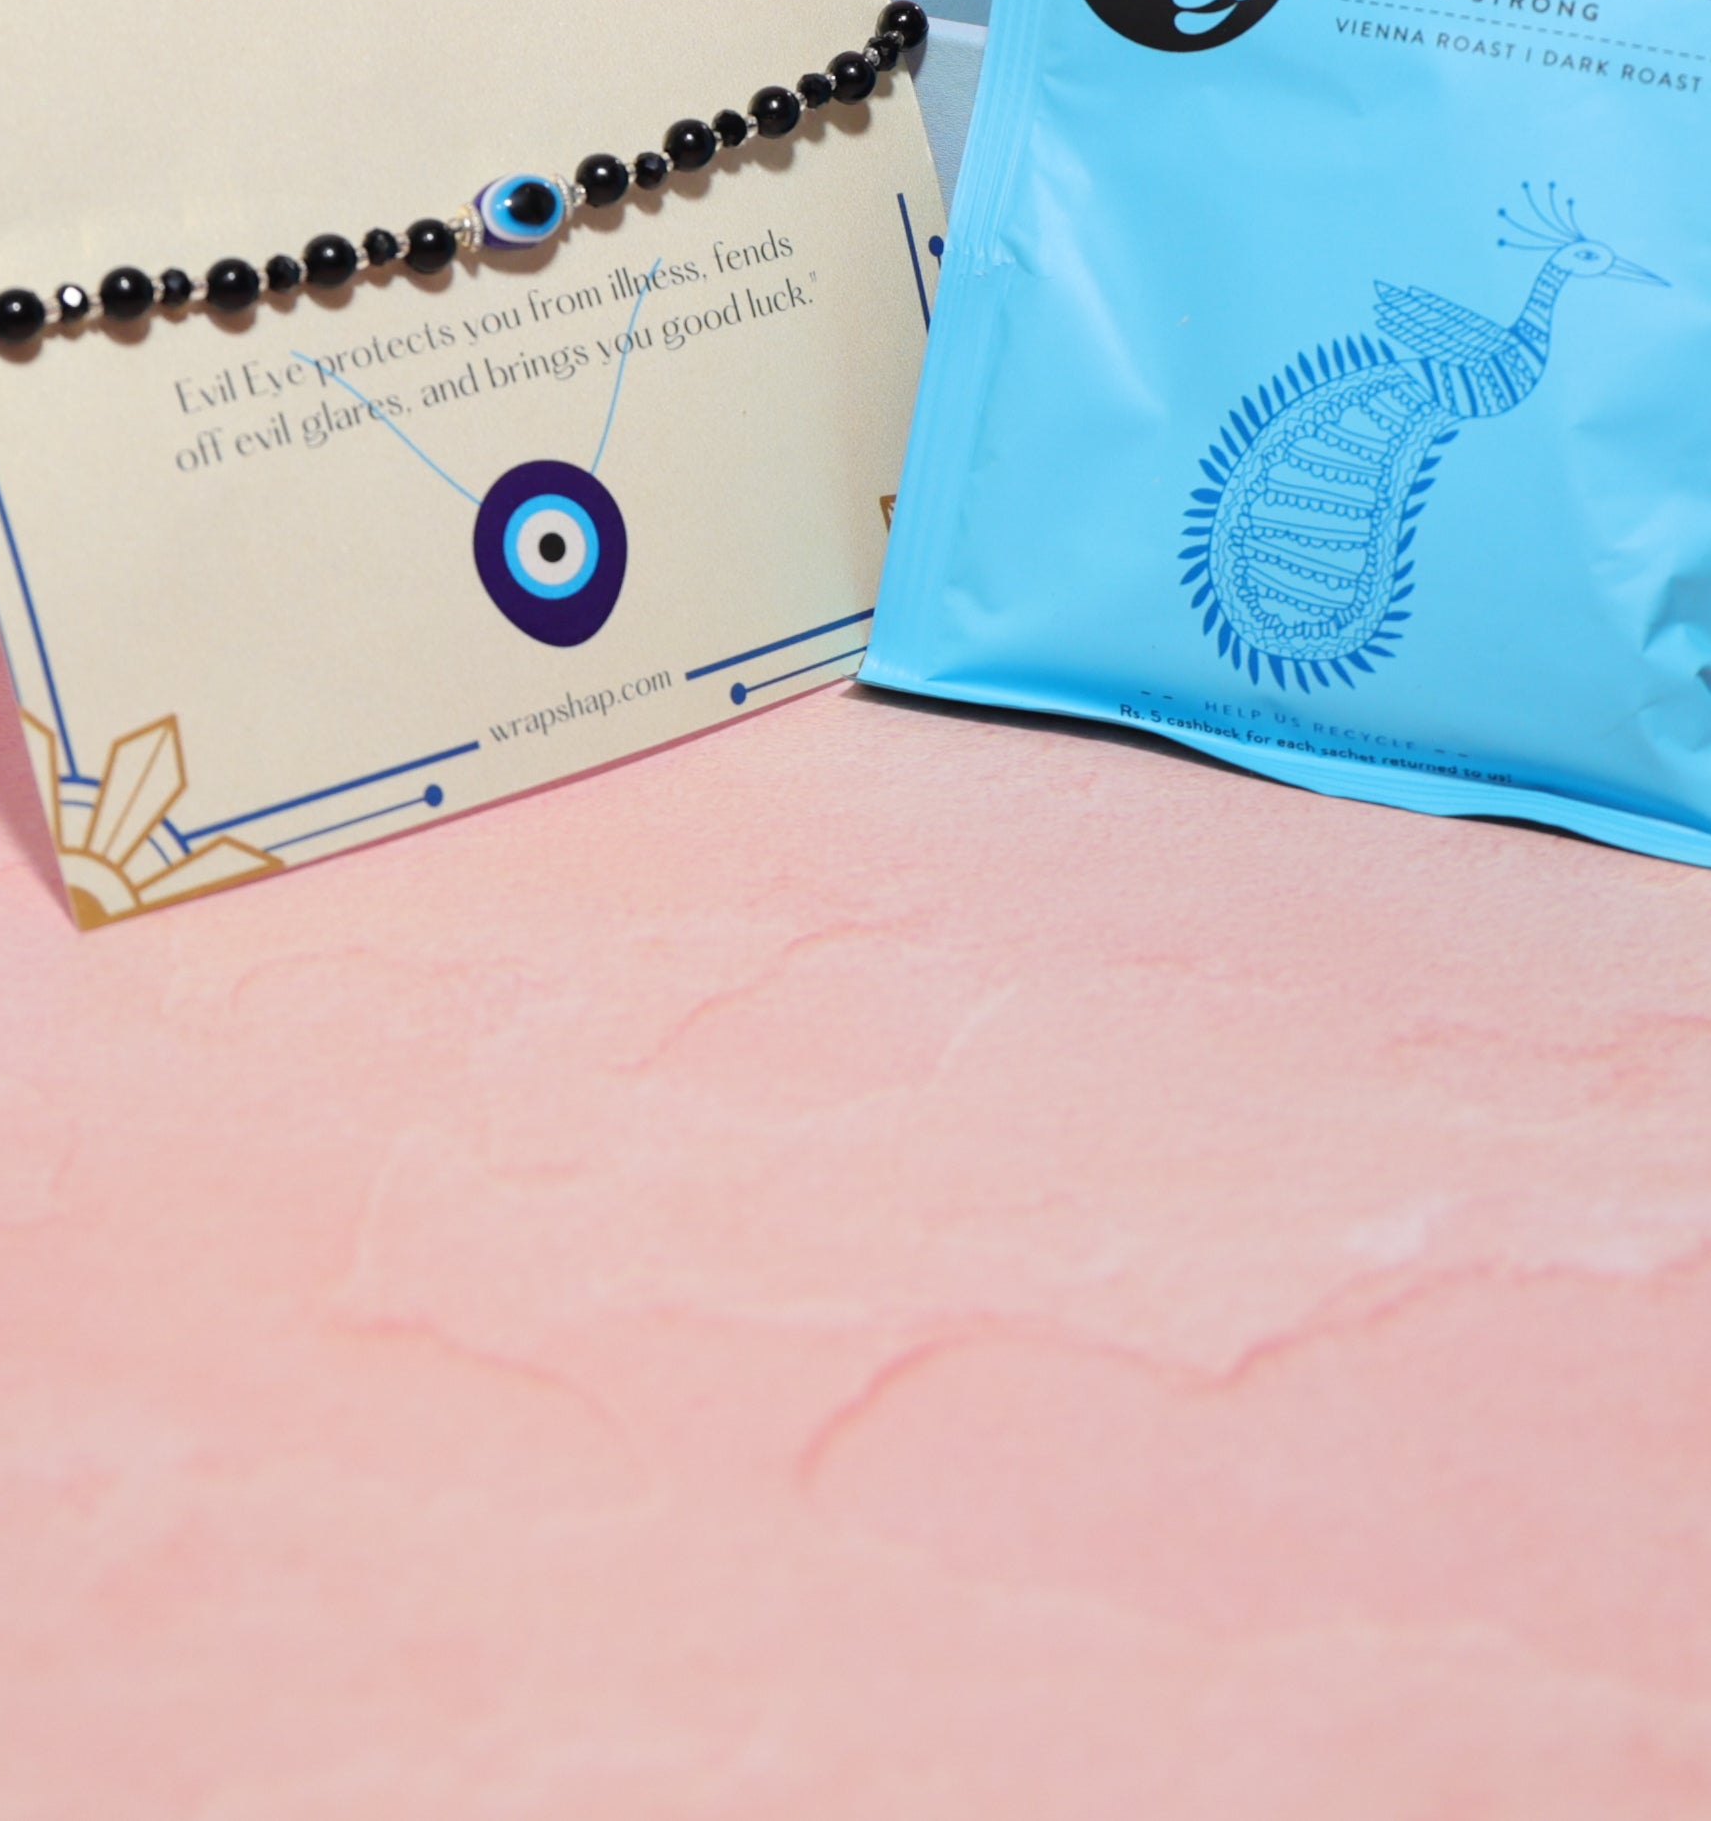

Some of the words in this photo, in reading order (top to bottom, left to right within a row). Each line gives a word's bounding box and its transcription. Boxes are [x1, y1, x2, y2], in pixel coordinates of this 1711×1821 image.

[1335, 17, 1426, 46] VIENNA
[1436, 30, 1516, 61] ROAST
[1542, 48, 1610, 77] DARK
[1620, 63, 1704, 94] ROAST
[174, 367, 238, 416] Evil
[240, 359, 304, 398] Eye
[314, 320, 456, 387] protects
[462, 307, 521, 346] you
[527, 284, 602, 322] from
[712, 228, 794, 273] fends
[175, 427, 224, 473] off
[235, 412, 292, 457] evil
[421, 362, 480, 408] and
[486, 344, 589, 388] brings
[596, 327, 653, 366] you
[662, 292, 742, 350] good
[488, 667, 673, 744] wrapshap.com
[1120, 703, 1145, 720] Rs.
[1150, 709, 1162, 723] 5
[1166, 715, 1241, 741] cashback
[1246, 729, 1272, 746] for
[1276, 737, 1316, 754] each
[1320, 746, 1376, 765] sachet
[1381, 755, 1458, 776] returned
[1463, 768, 1482, 778] to
[1204, 701, 1262, 721] HELP
[1274, 713, 1301, 728] US
[1313, 722, 1416, 750] RECYCLE
